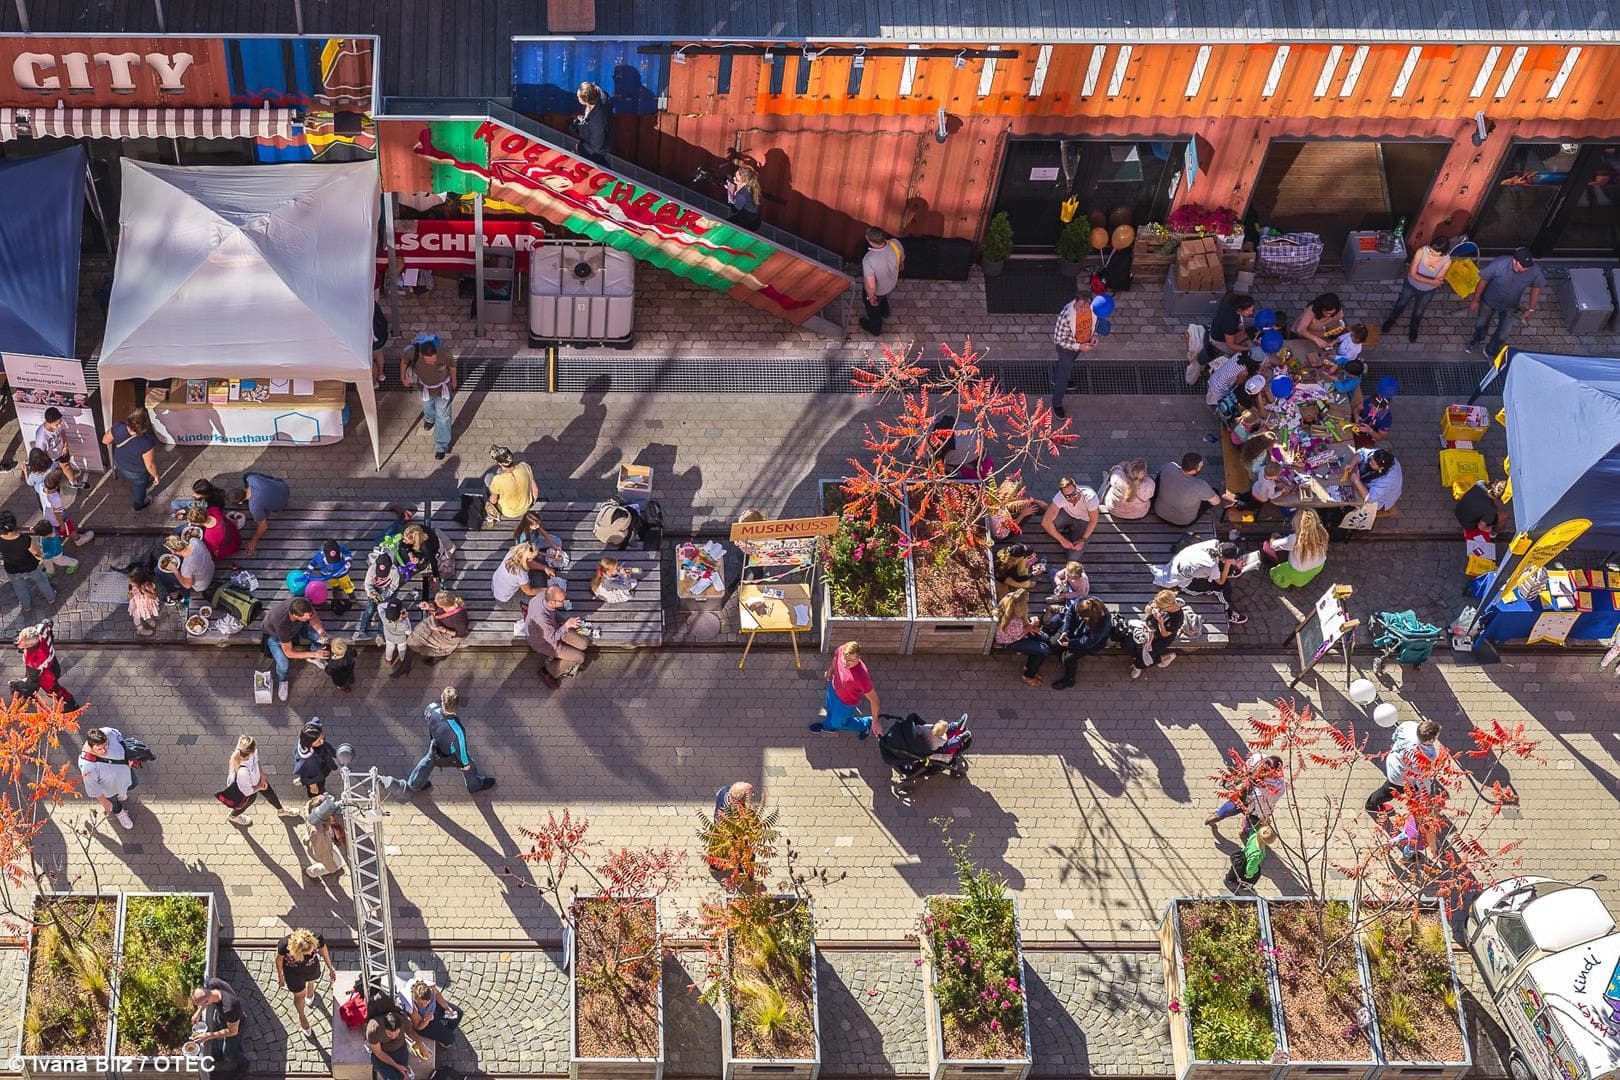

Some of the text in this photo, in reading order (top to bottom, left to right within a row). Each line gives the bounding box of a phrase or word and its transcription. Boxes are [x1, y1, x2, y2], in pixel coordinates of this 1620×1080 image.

[13, 51, 194, 93] CITY
[473, 120, 704, 228] KOELSCHBAR
[177, 433, 277, 443] kinderkunsthaus
[741, 521, 828, 534] MUSENKUSS
